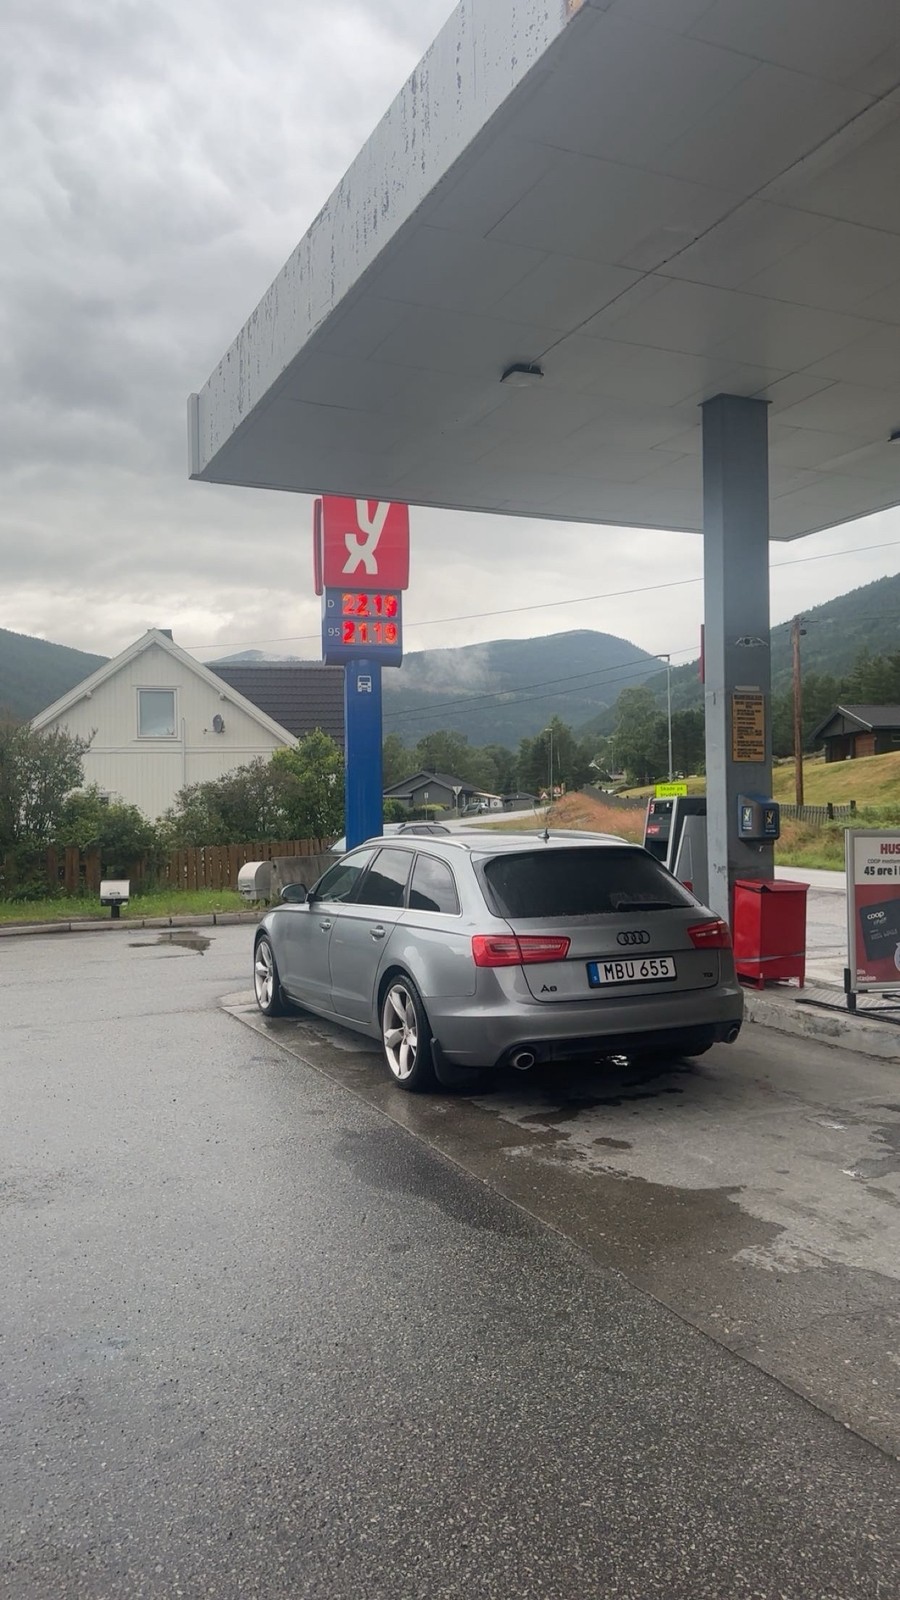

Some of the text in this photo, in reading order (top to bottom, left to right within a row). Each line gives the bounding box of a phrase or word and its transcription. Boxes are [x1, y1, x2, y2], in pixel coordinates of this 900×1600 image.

[327, 593, 398, 618] D 22.19
[327, 620, 398, 645] 95 21.19
[864, 866, 875, 876] 45
[877, 867, 893, 876] øre
[867, 911, 885, 920] coop
[603, 962, 635, 981] MBU
[640, 959, 669, 978] 655
